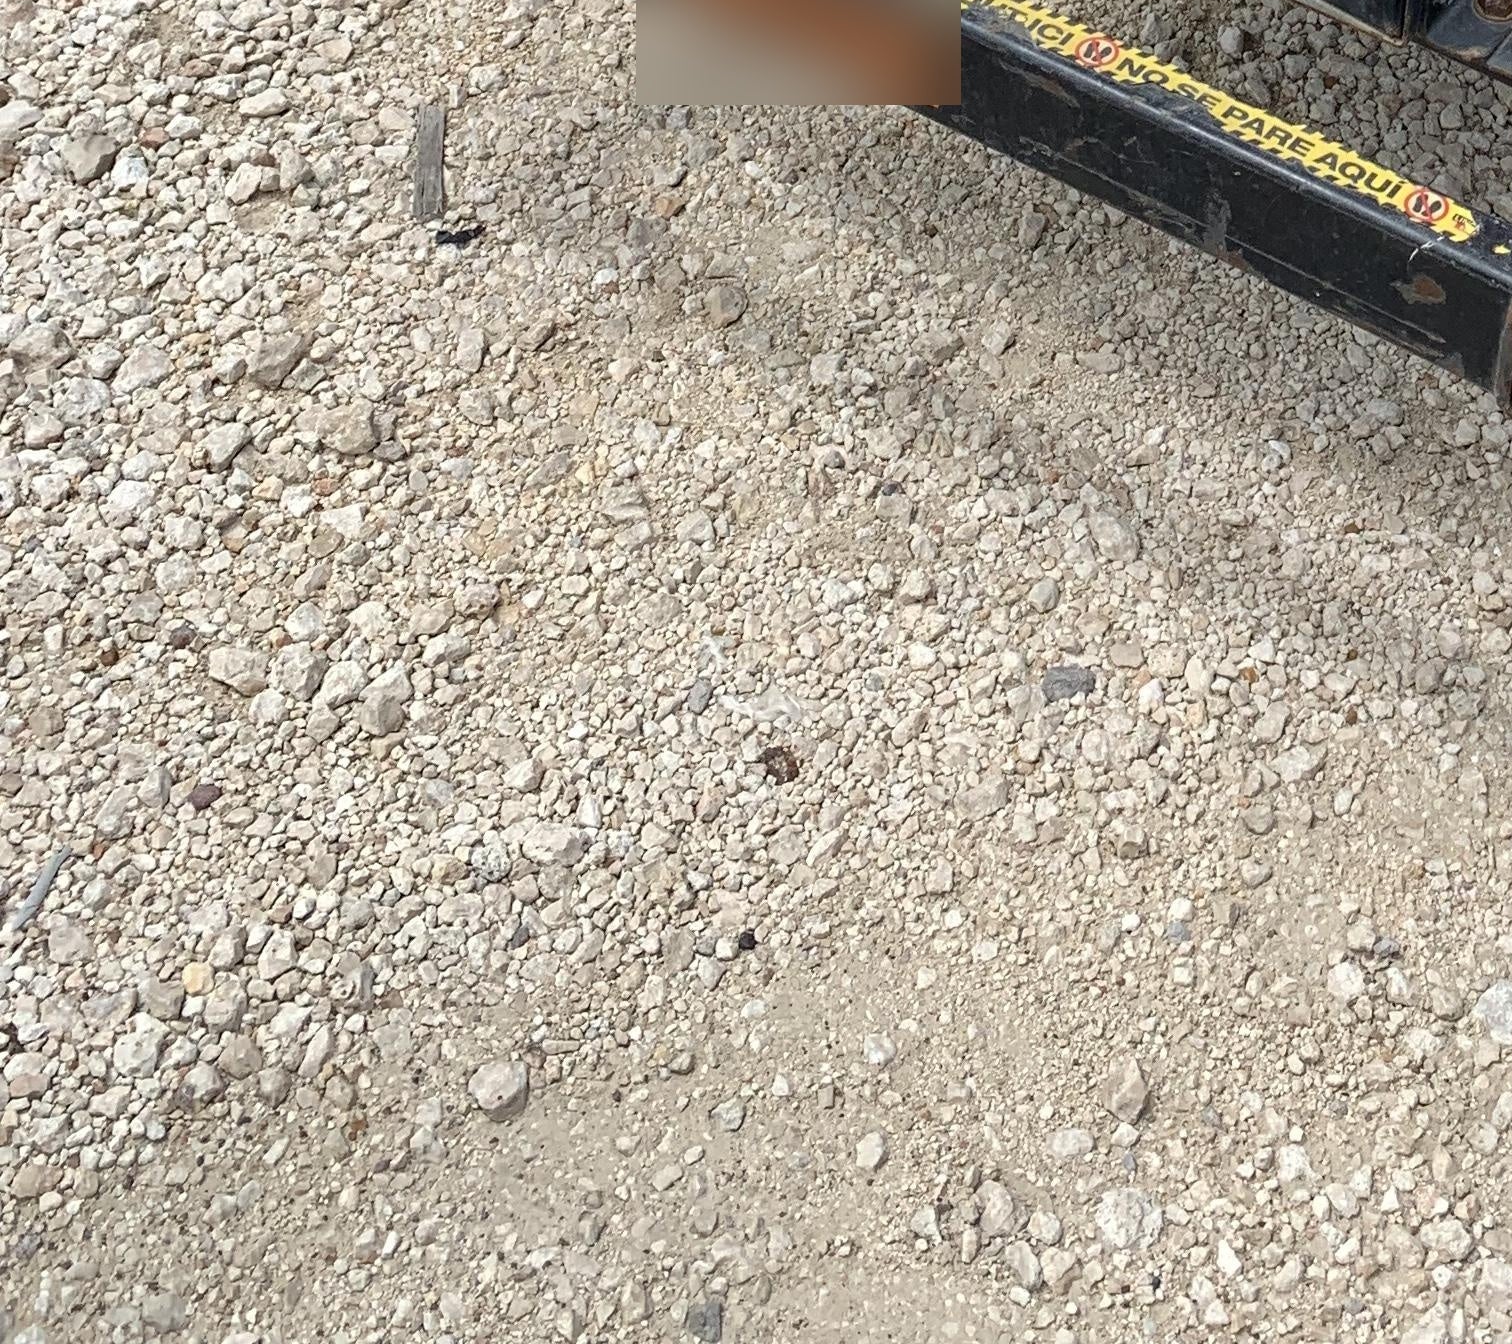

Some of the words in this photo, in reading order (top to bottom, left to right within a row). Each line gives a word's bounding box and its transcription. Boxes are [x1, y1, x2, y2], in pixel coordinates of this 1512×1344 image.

[1027, 19, 1075, 46] ICI
[1115, 57, 1169, 86] NO
[1177, 82, 1222, 110] SE
[1221, 105, 1316, 158] PARE
[1312, 150, 1407, 199] AQUÍ
